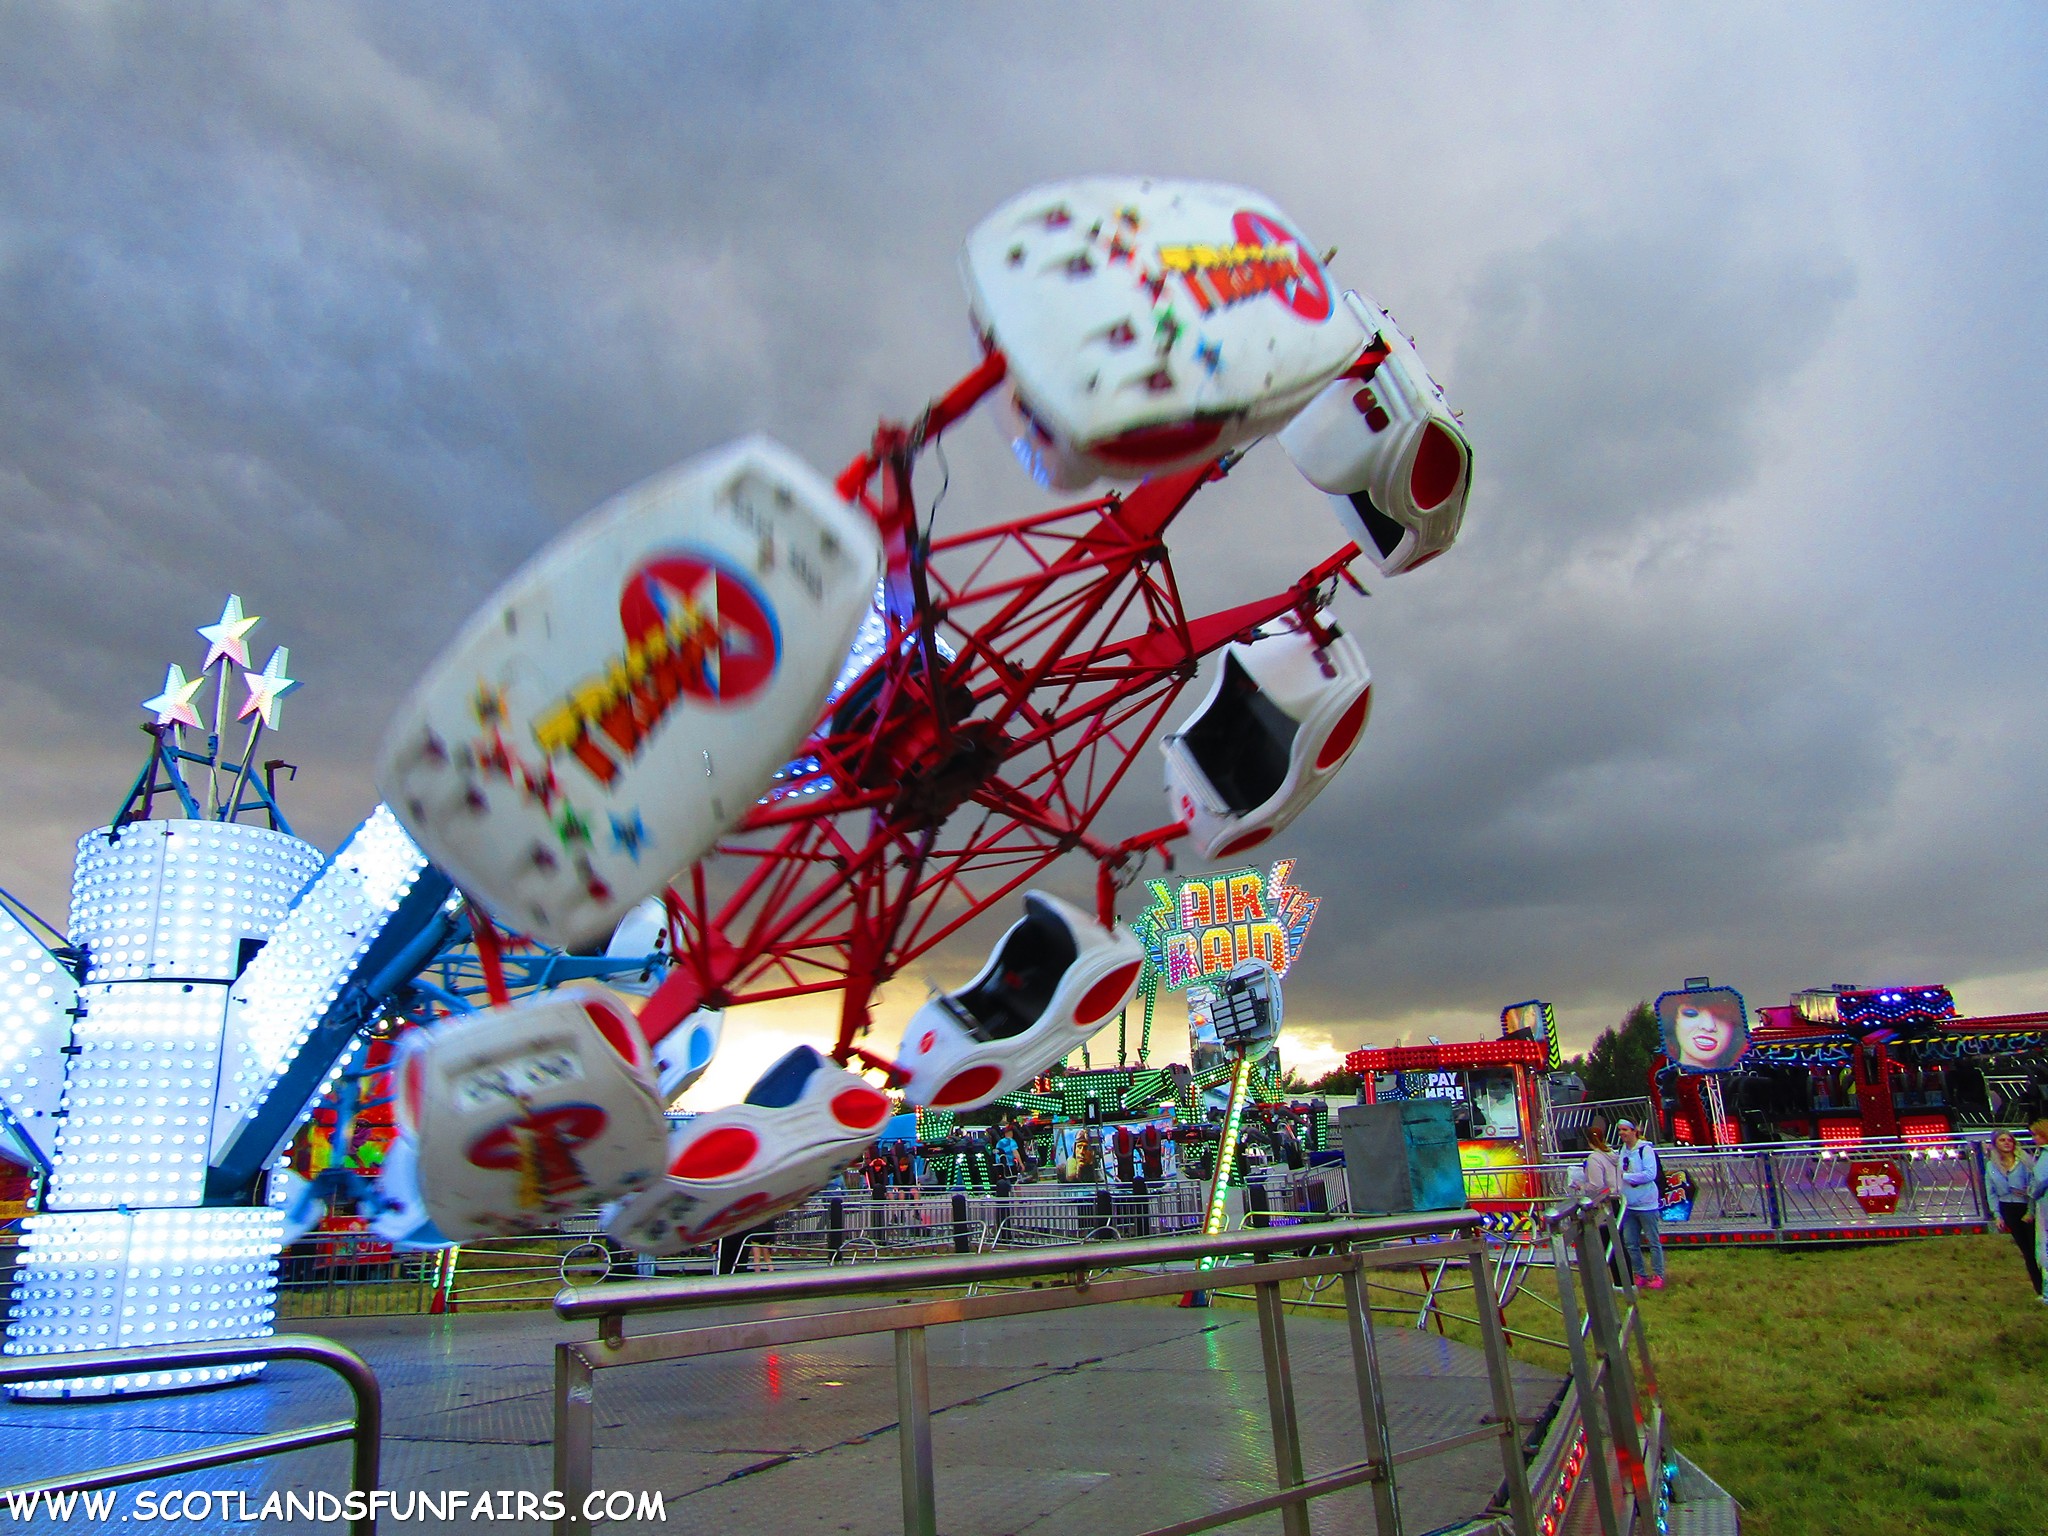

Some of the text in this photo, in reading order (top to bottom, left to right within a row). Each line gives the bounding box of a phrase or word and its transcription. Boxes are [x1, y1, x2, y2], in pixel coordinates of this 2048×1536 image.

[1180, 873, 1267, 930] AIR
[1166, 921, 1288, 988] RAID
[1428, 1072, 1457, 1086] PAY
[1425, 1086, 1464, 1100] HERE
[1857, 1174, 1889, 1186] TOP
[1856, 1184, 1896, 1197] STAR
[1689, 1233, 1744, 1244] STAR
